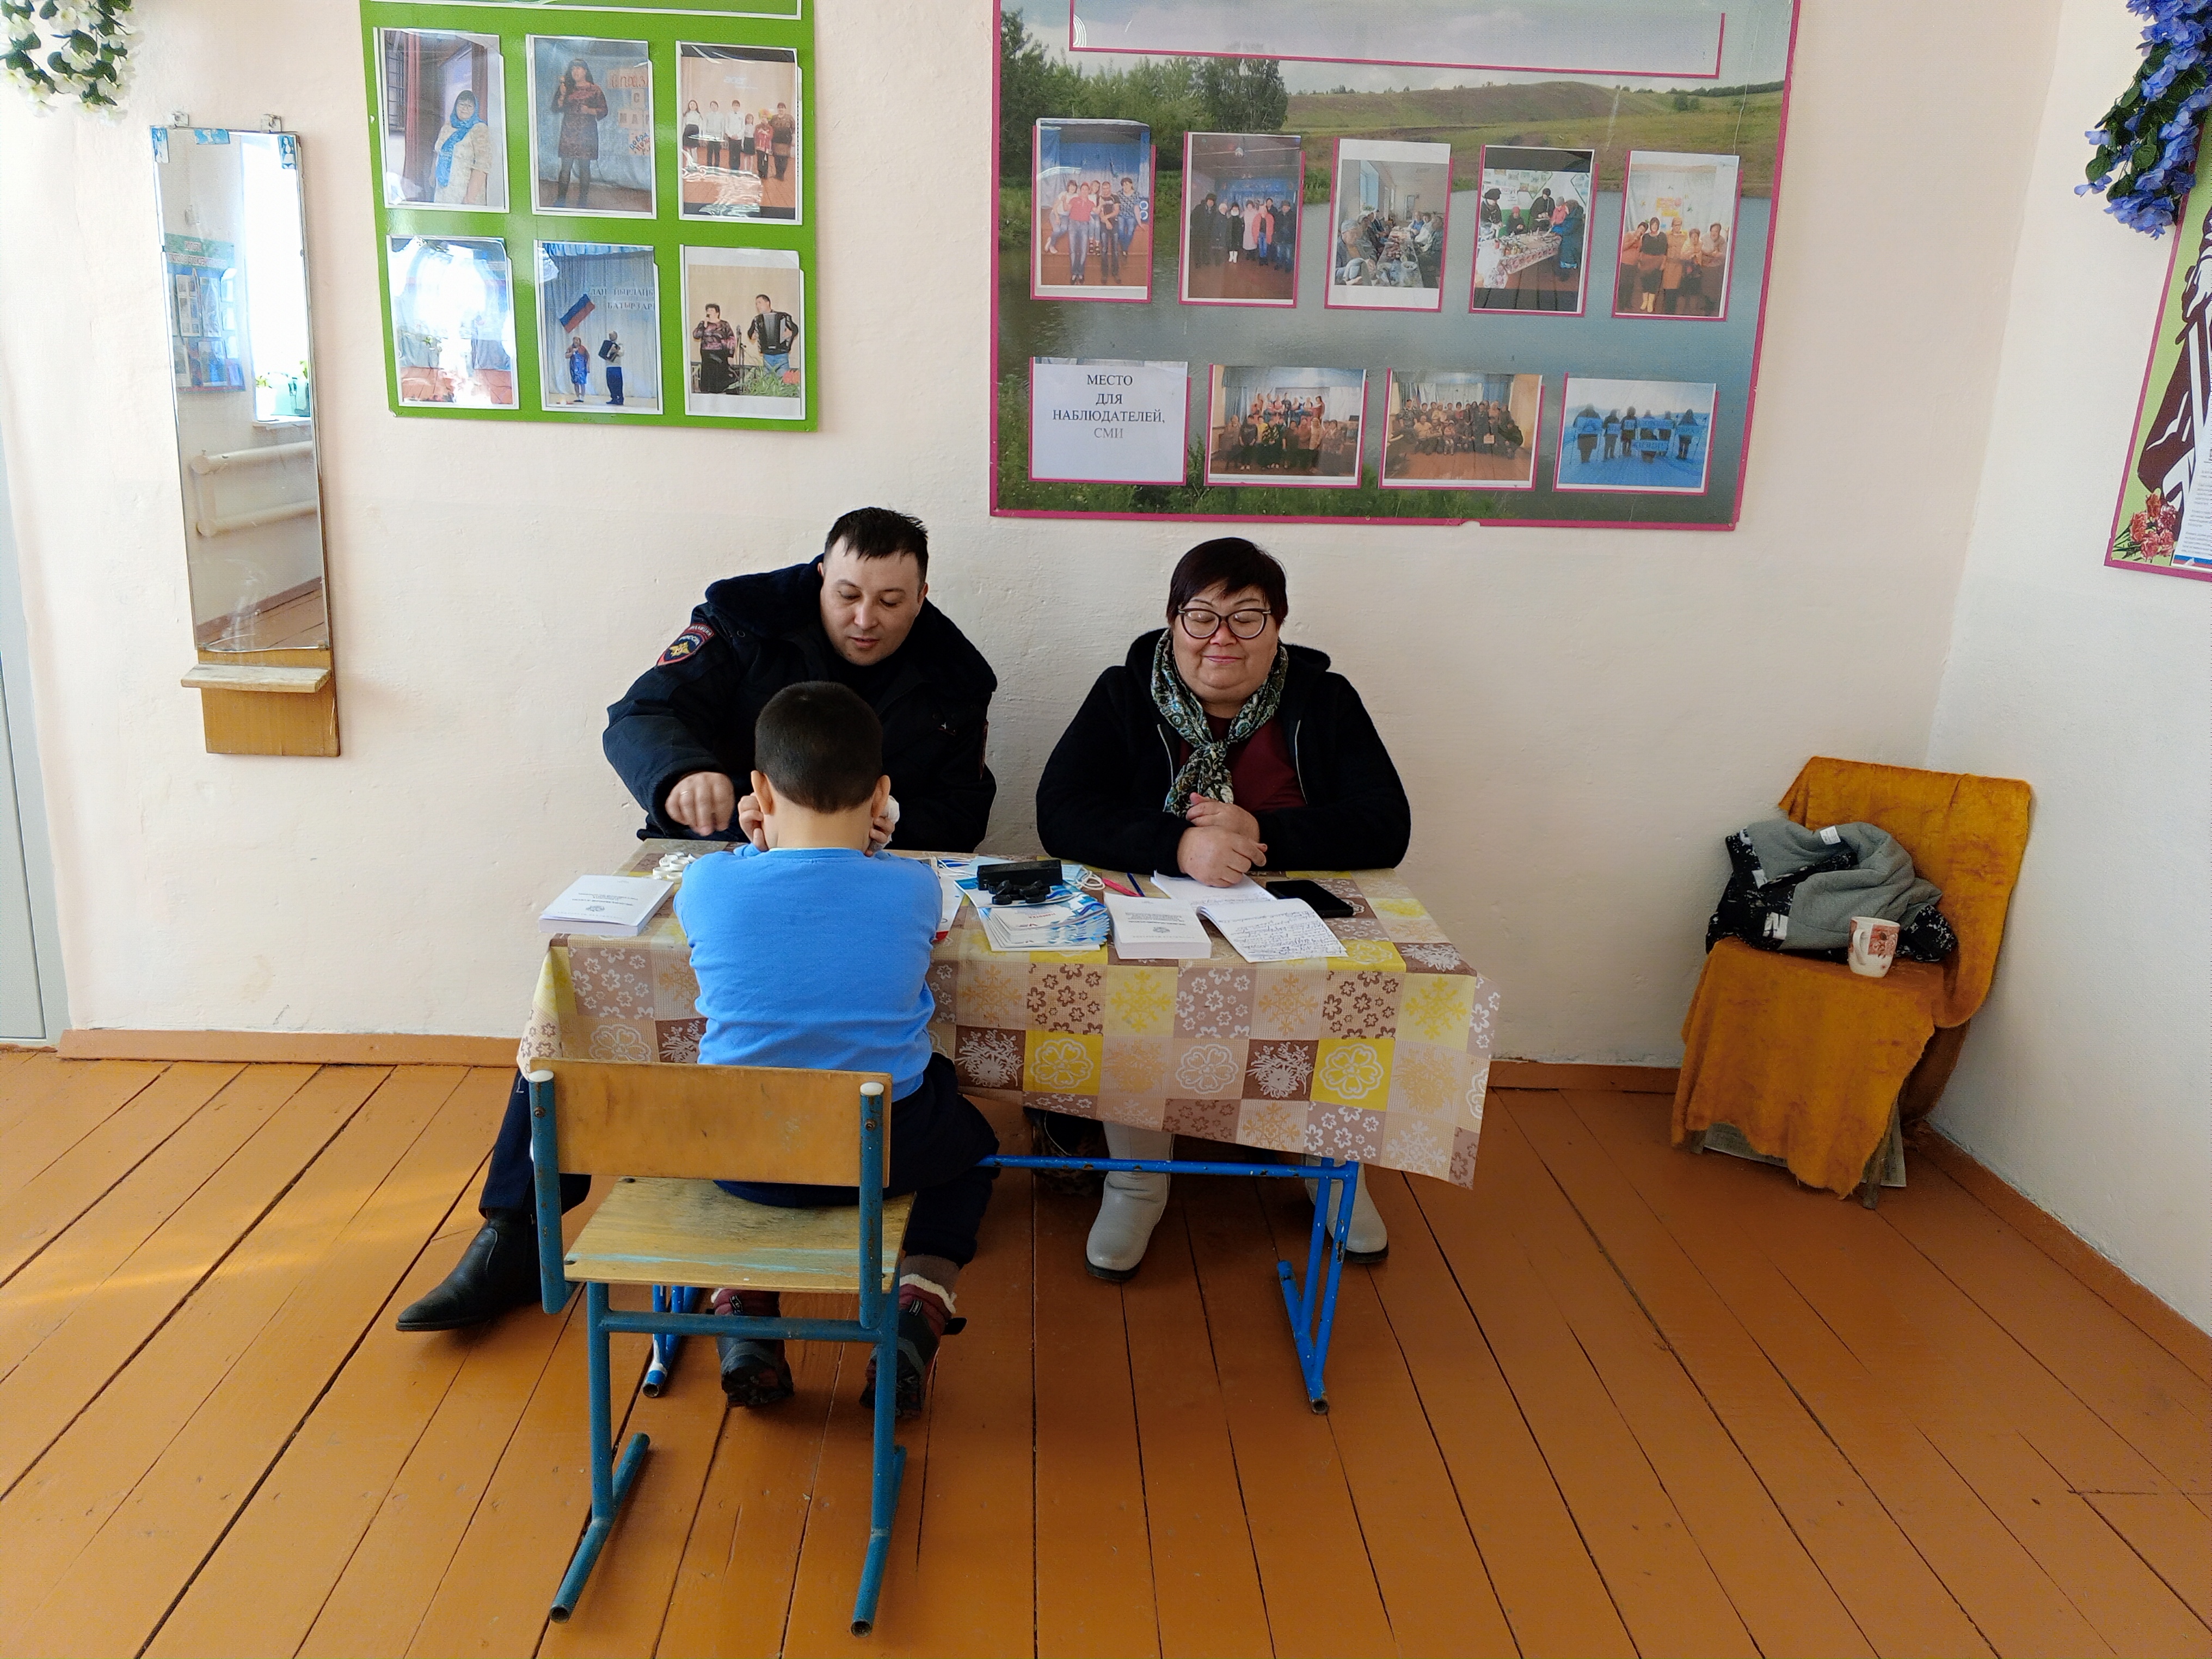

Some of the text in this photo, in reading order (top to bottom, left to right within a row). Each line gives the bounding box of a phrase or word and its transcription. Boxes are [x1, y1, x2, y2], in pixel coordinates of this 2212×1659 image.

[1087, 374, 1133, 386] МЕСТО
[1096, 394, 1122, 405] ДЛЯ
[1053, 409, 1165, 423] НАБЛЮДАТЕЛЕЙ,
[1094, 428, 1123, 439] СМИ
